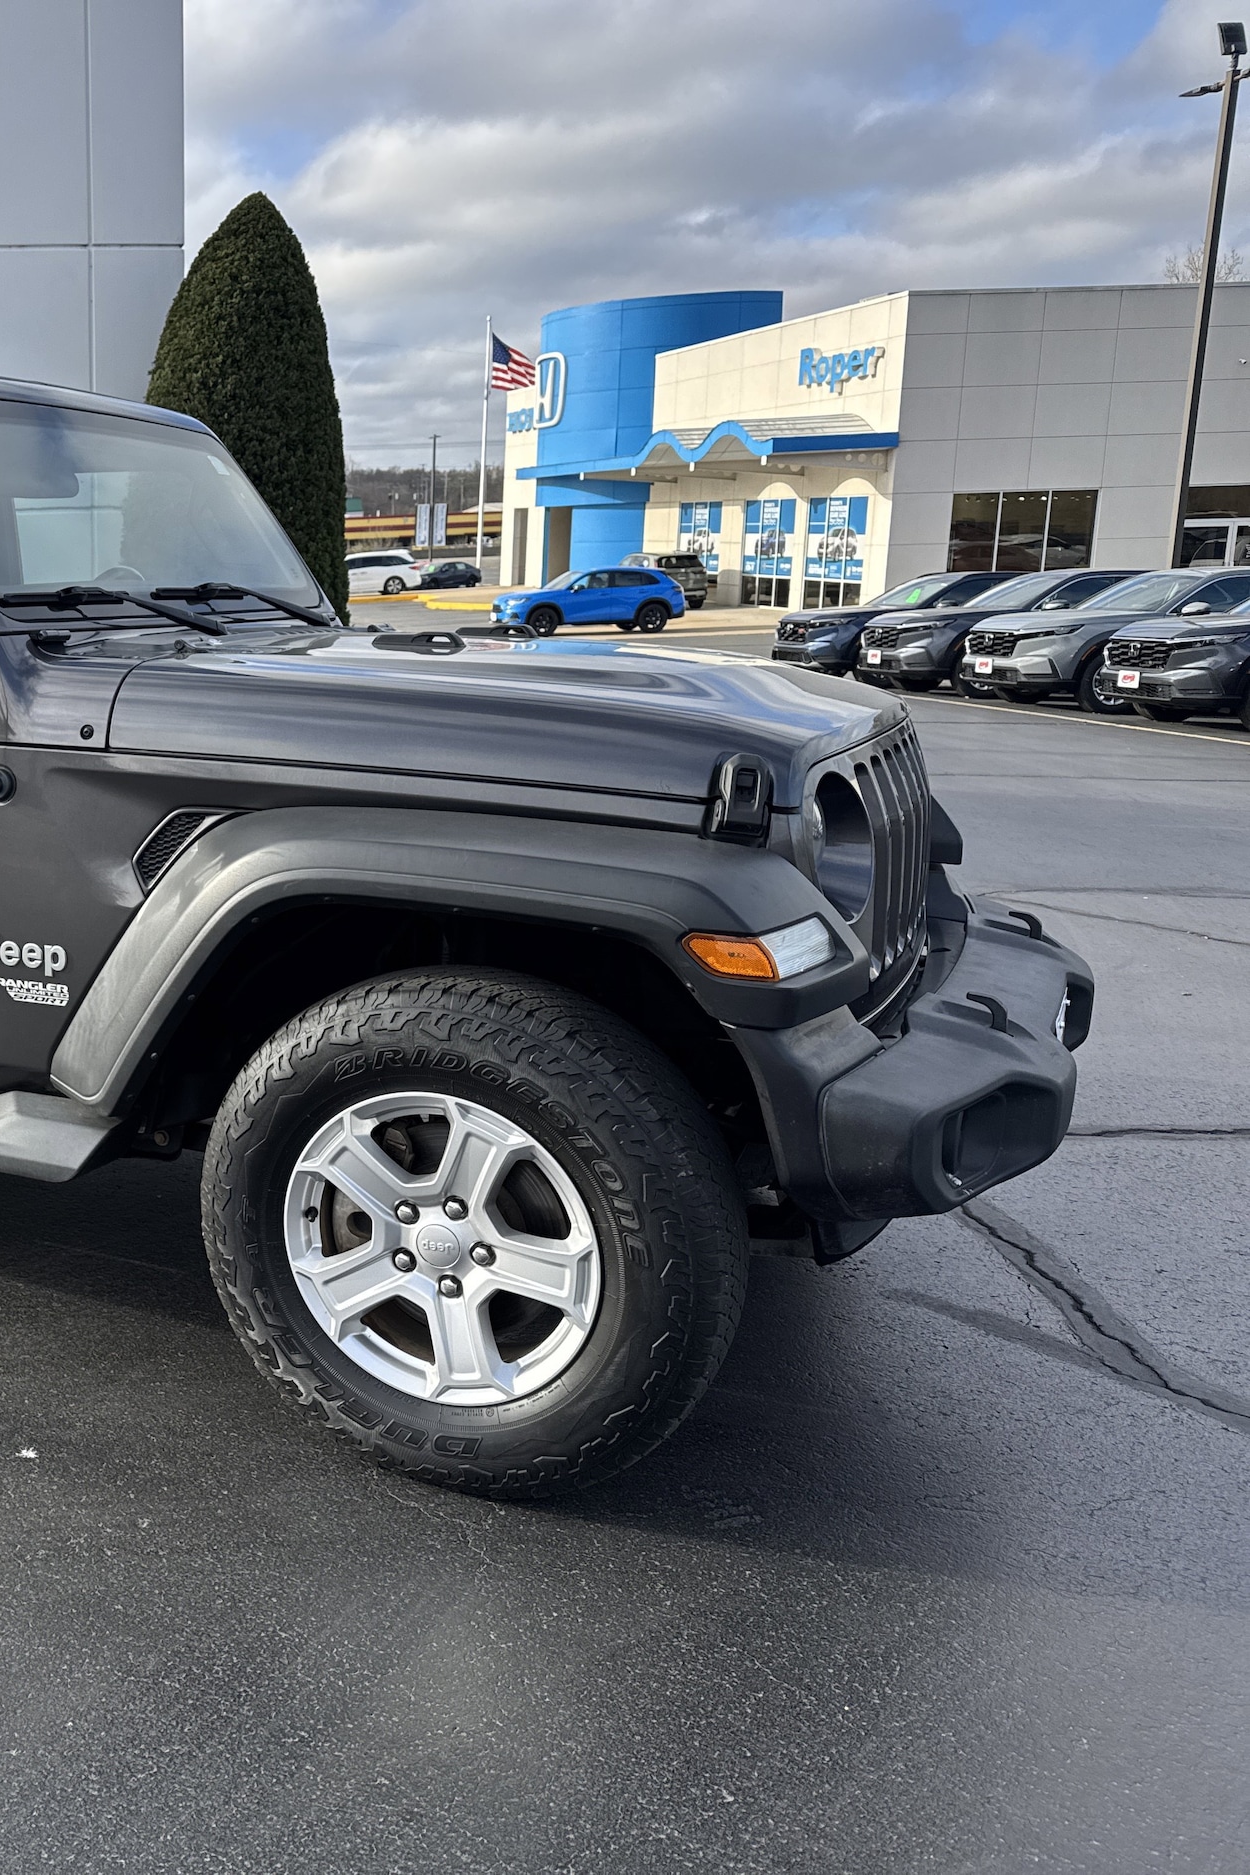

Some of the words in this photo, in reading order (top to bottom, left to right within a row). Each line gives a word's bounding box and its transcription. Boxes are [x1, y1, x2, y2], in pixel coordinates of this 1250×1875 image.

[798, 346, 884, 394] Roper
[6, 986, 70, 998] UNLIMITED
[12, 993, 66, 1005] SPORT
[333, 1044, 651, 1268] BRIDGESTONE
[421, 1238, 454, 1255] Jeep
[252, 1286, 484, 1458] DUELER
